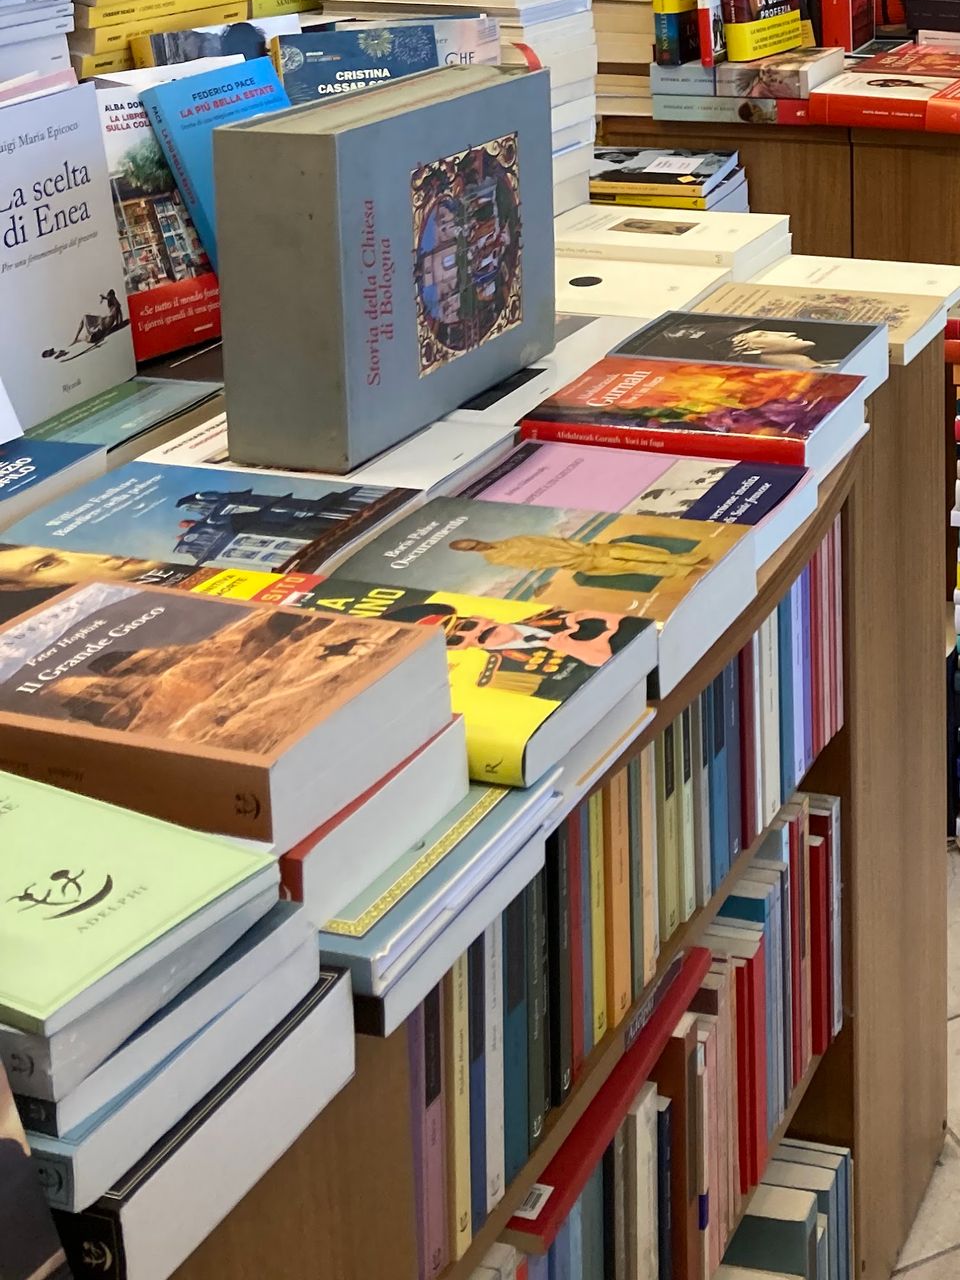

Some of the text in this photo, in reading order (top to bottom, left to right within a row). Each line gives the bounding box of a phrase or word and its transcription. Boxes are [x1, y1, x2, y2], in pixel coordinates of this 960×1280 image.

[760, 4, 791, 19] PROFEZIA
[192, 77, 255, 102] FEDERICO PACE
[335, 68, 390, 81] CRISTINA
[104, 103, 125, 112] ALBA
[109, 115, 120, 123] LA
[180, 110, 193, 119] LA
[213, 95, 241, 110] BELLA
[243, 85, 274, 100] ESTATE
[19, 121, 79, 150] Maria Epicoco
[106, 124, 130, 132] SULLA
[33, 160, 91, 201] scelta
[3, 200, 91, 249] di Enea
[361, 199, 381, 386] Storia della Chiesa
[378, 237, 395, 340] di Bologna
[586, 369, 653, 407] Gurnah
[594, 434, 621, 444] Gurnah
[45, 478, 138, 527] William Faulkner
[384, 520, 441, 560] Boris Pahor
[390, 515, 471, 570] Oscuramento
[16, 606, 166, 695] Il Grande Gioco
[26, 619, 108, 668] Peter Hopkirk
[77, 885, 148, 934] ADELPHI
